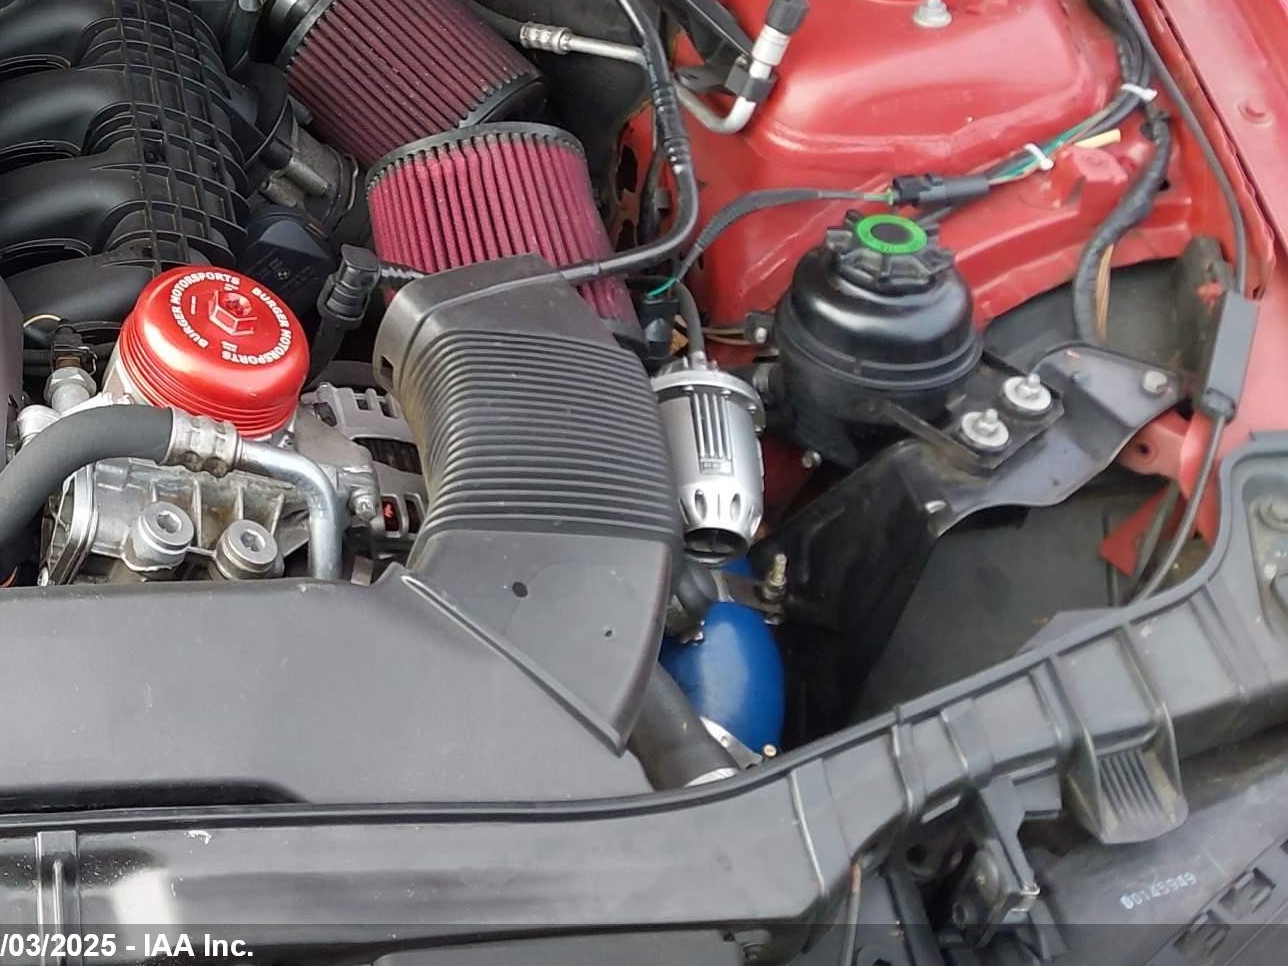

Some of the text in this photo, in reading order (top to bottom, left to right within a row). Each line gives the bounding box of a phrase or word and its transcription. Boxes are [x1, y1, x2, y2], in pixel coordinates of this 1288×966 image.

[170, 272, 240, 348] BURGER MOTORSPORTS
[222, 287, 292, 365] BURGER MOTORSPORTS
